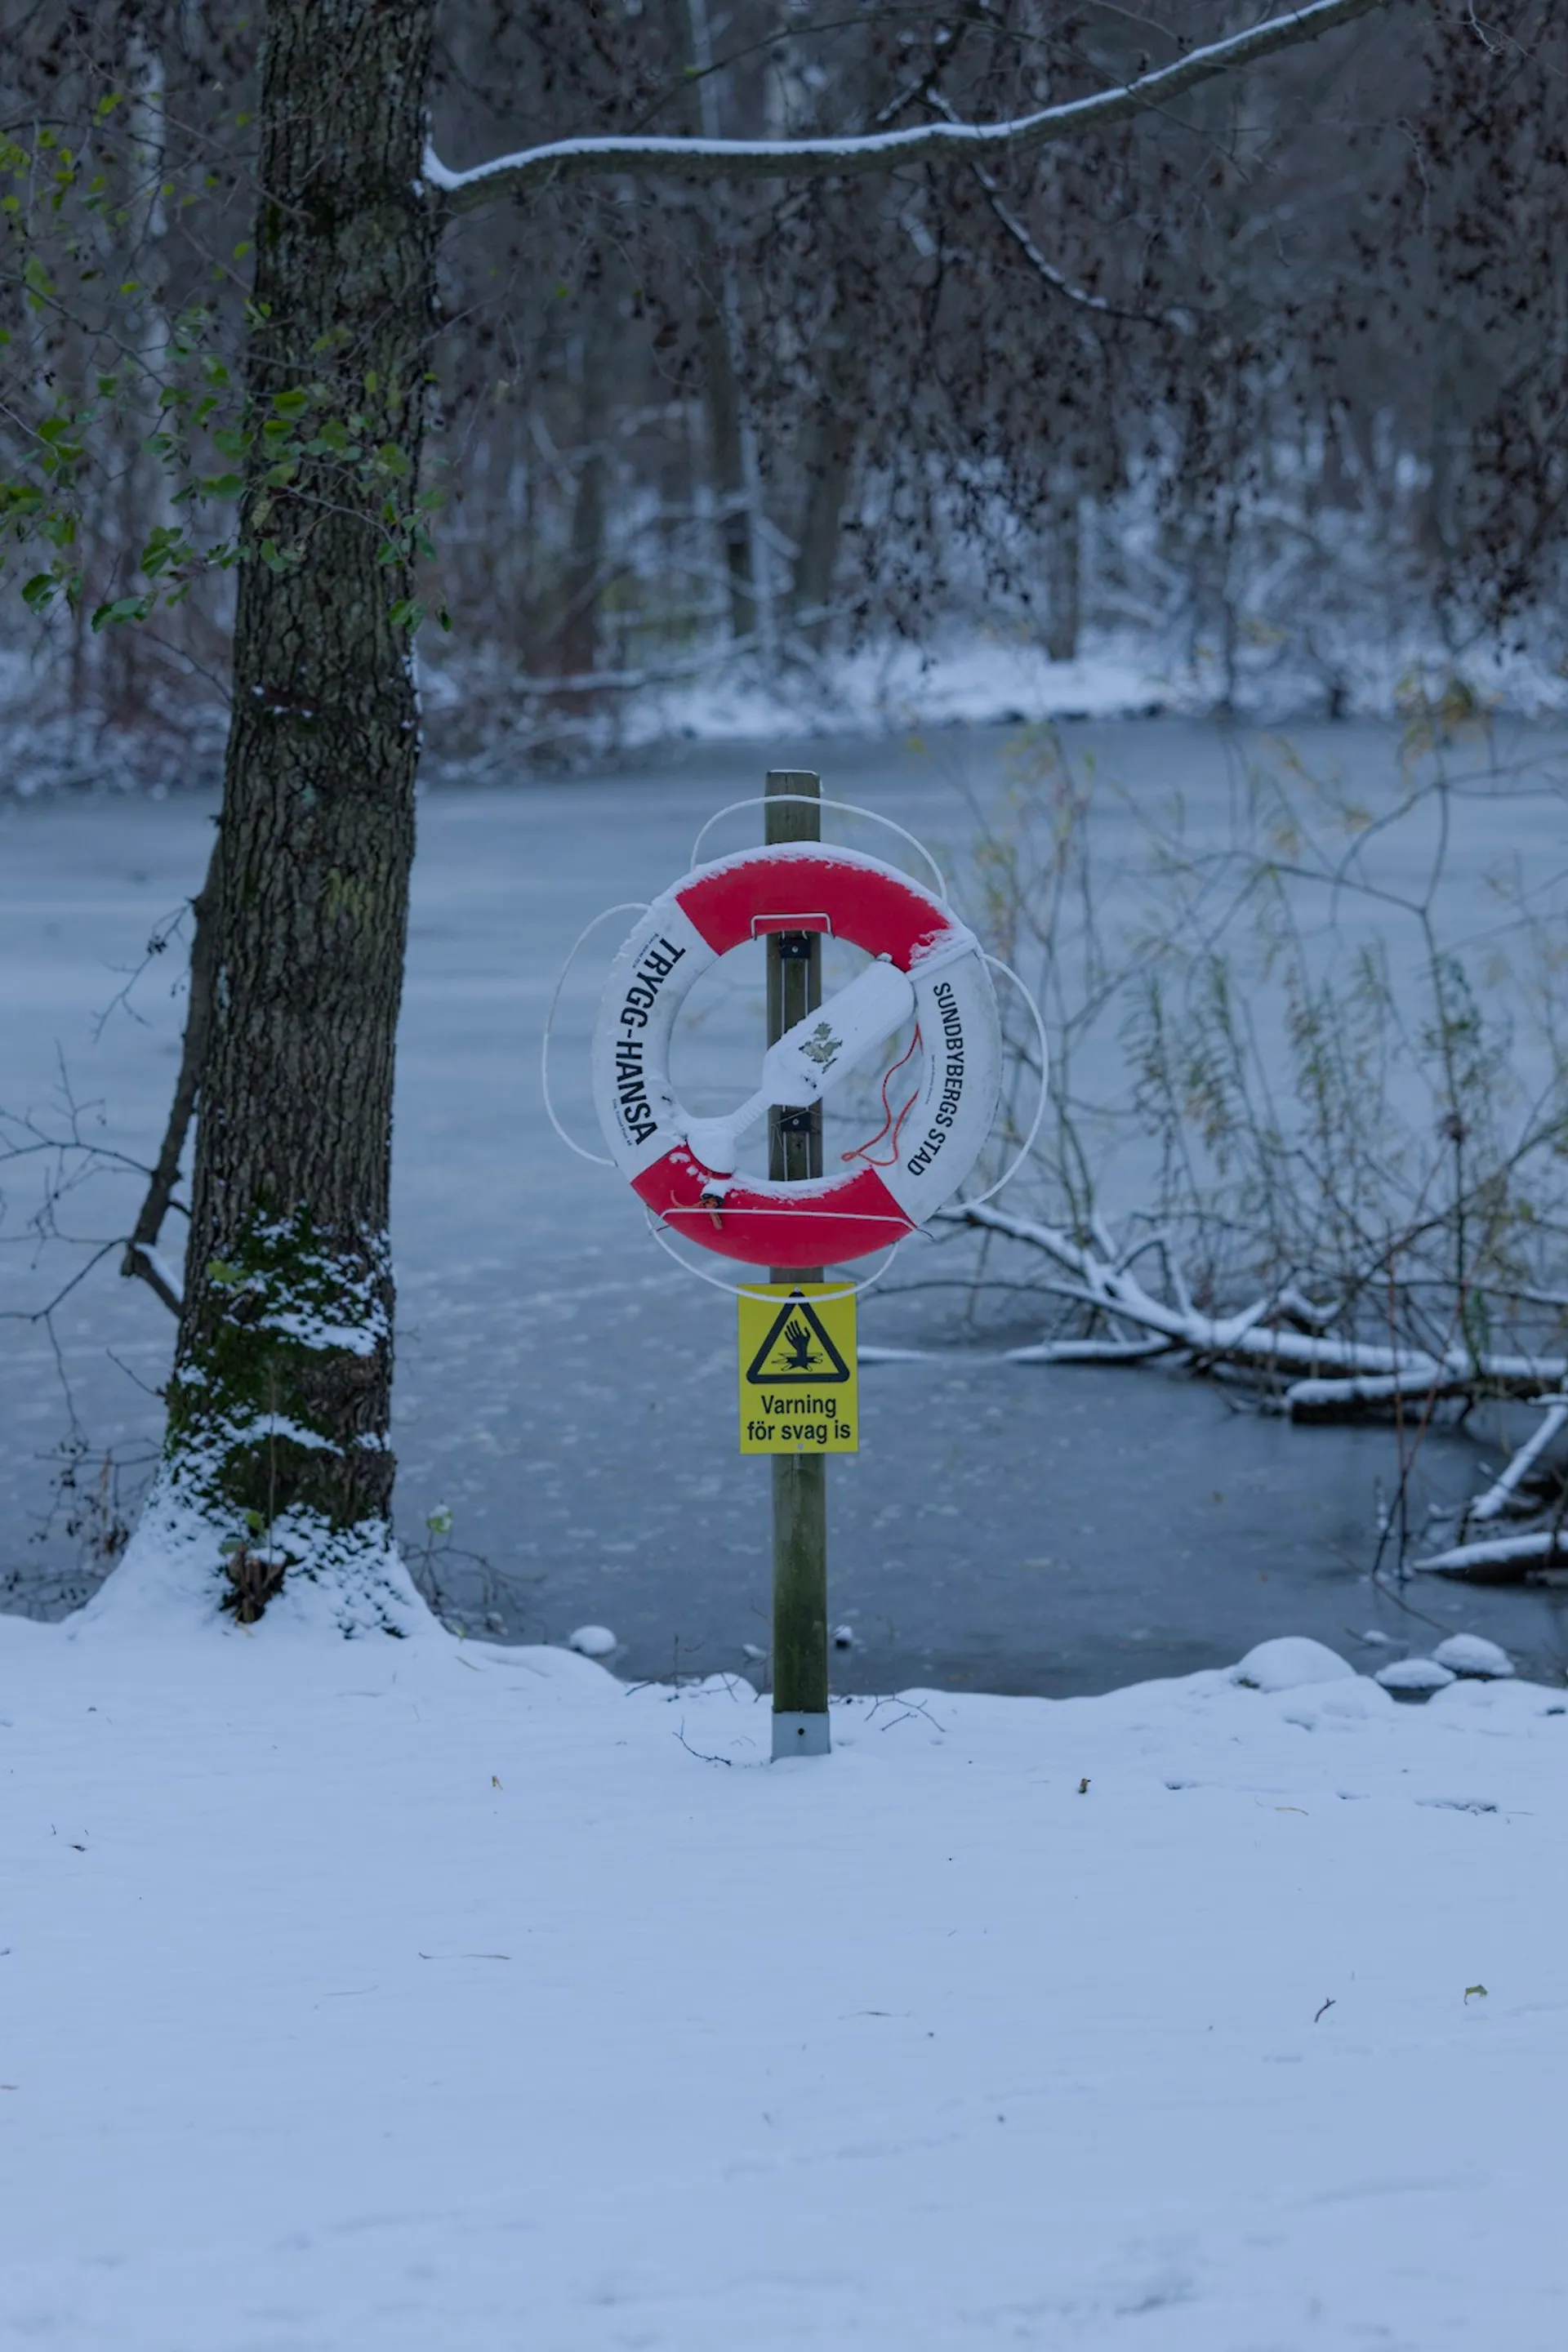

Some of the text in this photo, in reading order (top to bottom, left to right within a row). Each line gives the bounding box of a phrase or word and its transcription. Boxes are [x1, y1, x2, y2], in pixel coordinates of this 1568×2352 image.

[615, 938, 686, 1145] TRYGG-HANSA
[907, 982, 964, 1176] SUNDBYBERGS STAD
[747, 1420, 851, 1444] för svag is
[761, 1394, 837, 1419] Varning
